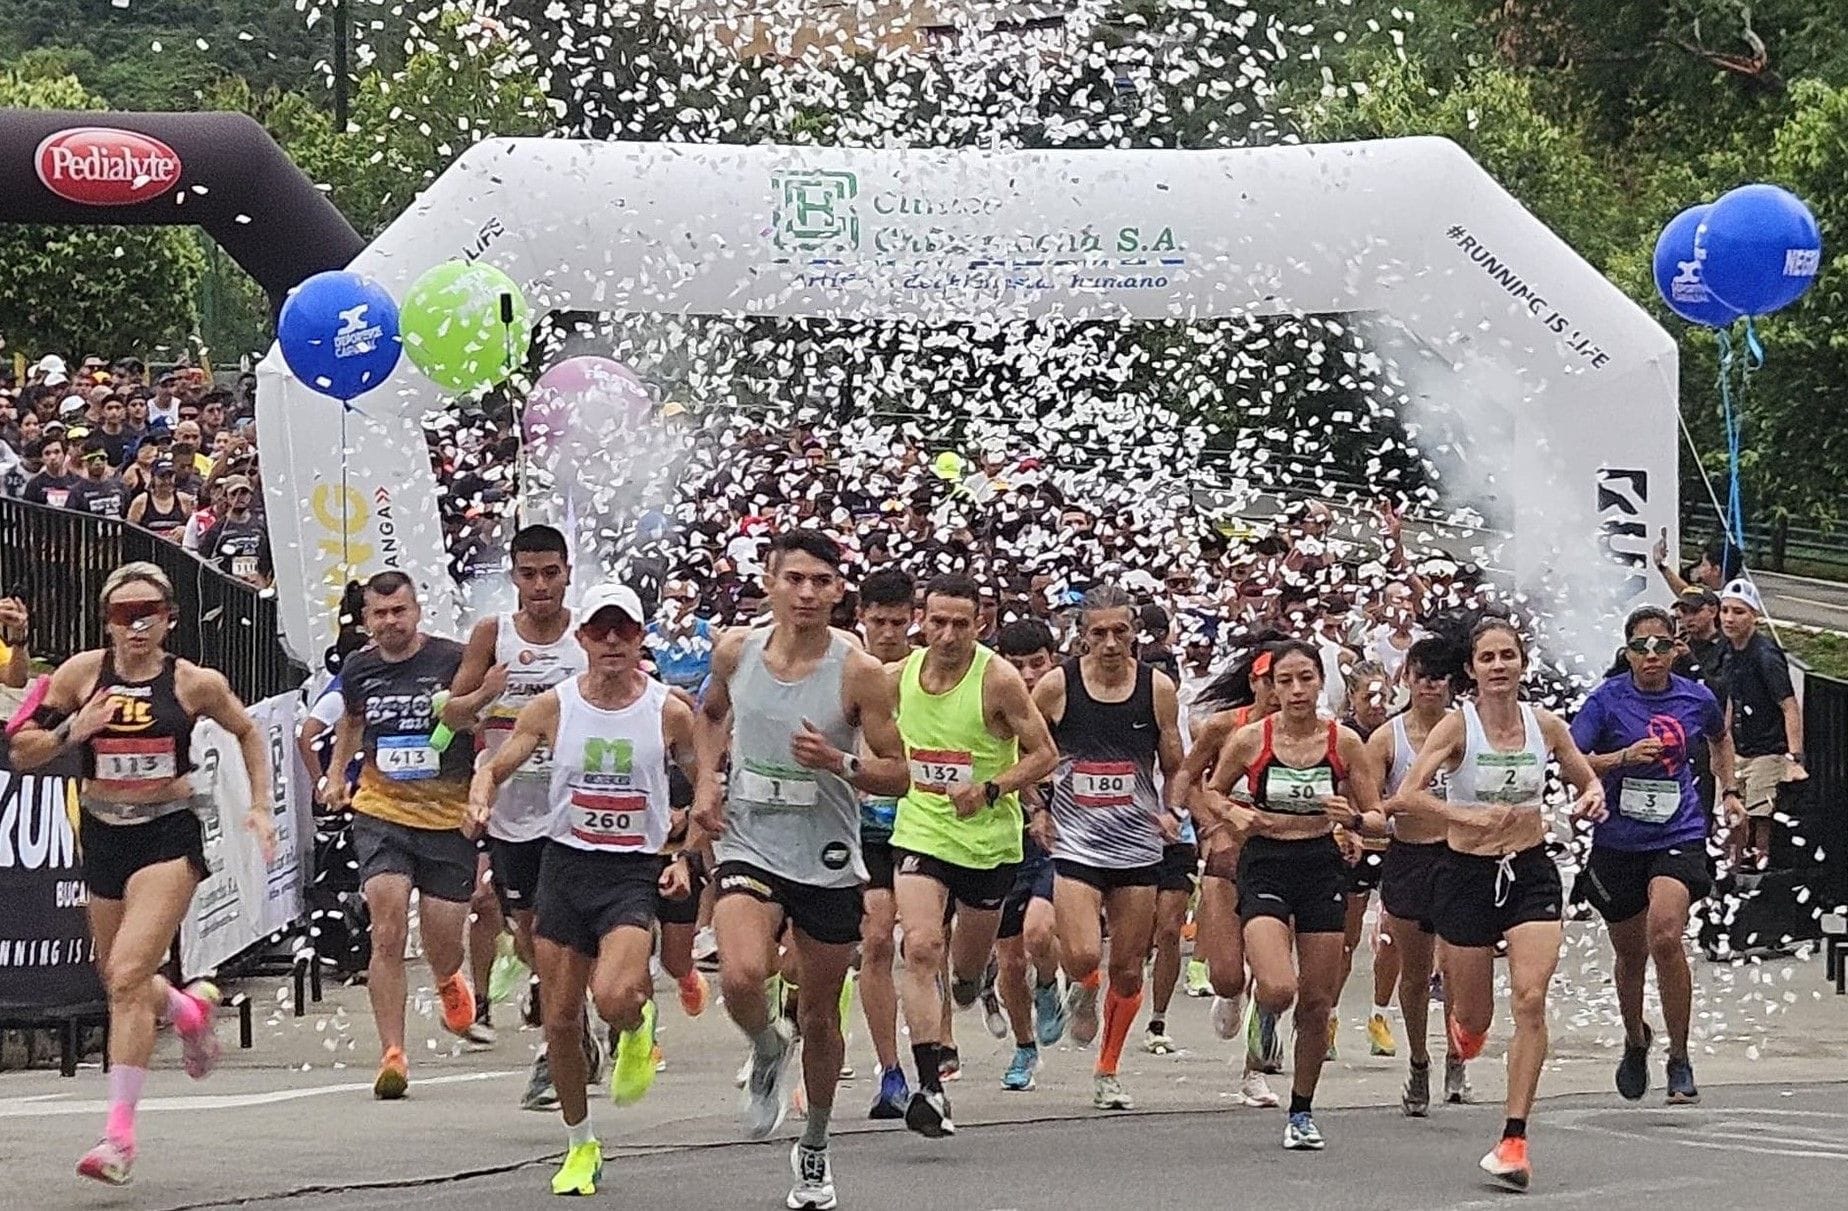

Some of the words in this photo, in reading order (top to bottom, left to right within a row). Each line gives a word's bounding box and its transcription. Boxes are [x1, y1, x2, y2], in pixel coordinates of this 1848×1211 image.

[50, 145, 175, 190] Pedialyte
[1116, 226, 1187, 252] S.A.
[1446, 225, 1548, 316] #RUNNING
[1543, 312, 1569, 333] IS
[112, 756, 158, 774] 113
[389, 750, 426, 765] 413
[921, 764, 959, 782] 132
[1505, 769, 1517, 785] 2
[771, 780, 781, 798] 1
[1088, 777, 1124, 791] 180
[1288, 784, 1315, 799] 30
[1645, 794, 1657, 808] 3
[585, 811, 631, 830] 260
[66, 938, 83, 965] IS
